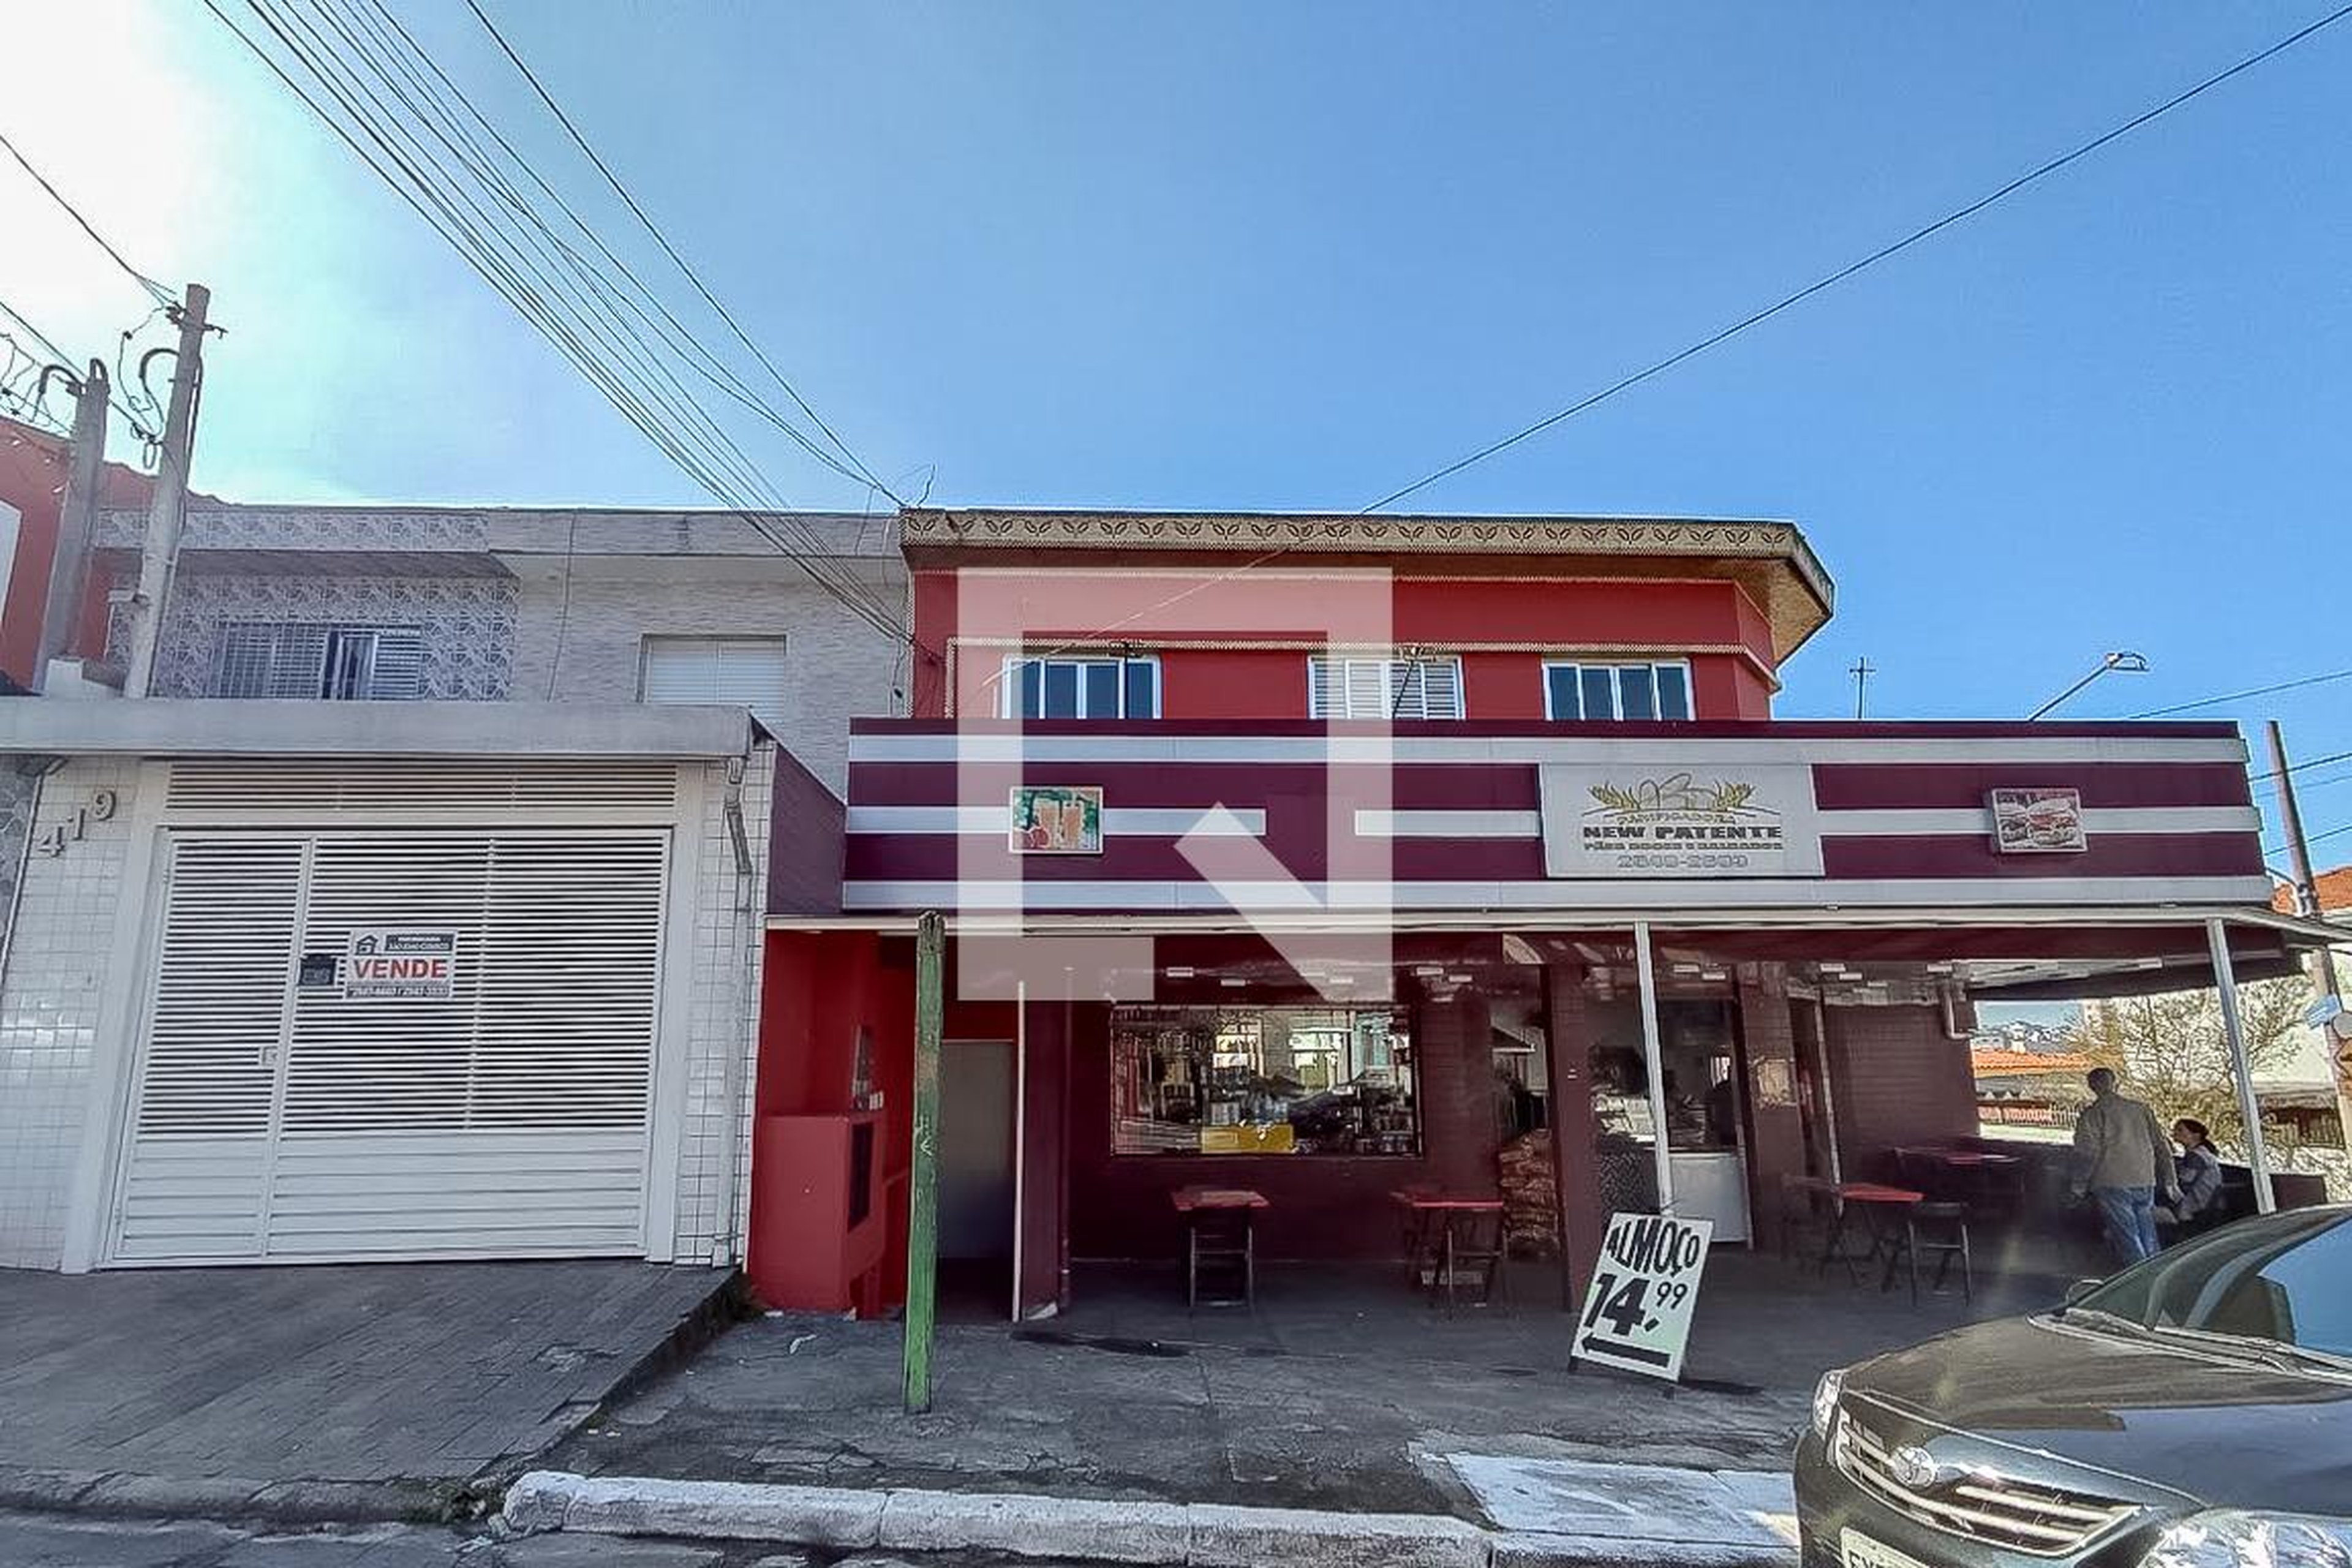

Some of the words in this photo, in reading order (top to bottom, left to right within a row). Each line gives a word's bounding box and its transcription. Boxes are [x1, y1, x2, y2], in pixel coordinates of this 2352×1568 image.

[37, 790, 116, 858] 419
[1583, 826, 1646, 838] NEW
[1655, 826, 1782, 839] PATENTE
[355, 959, 447, 979] VENDE
